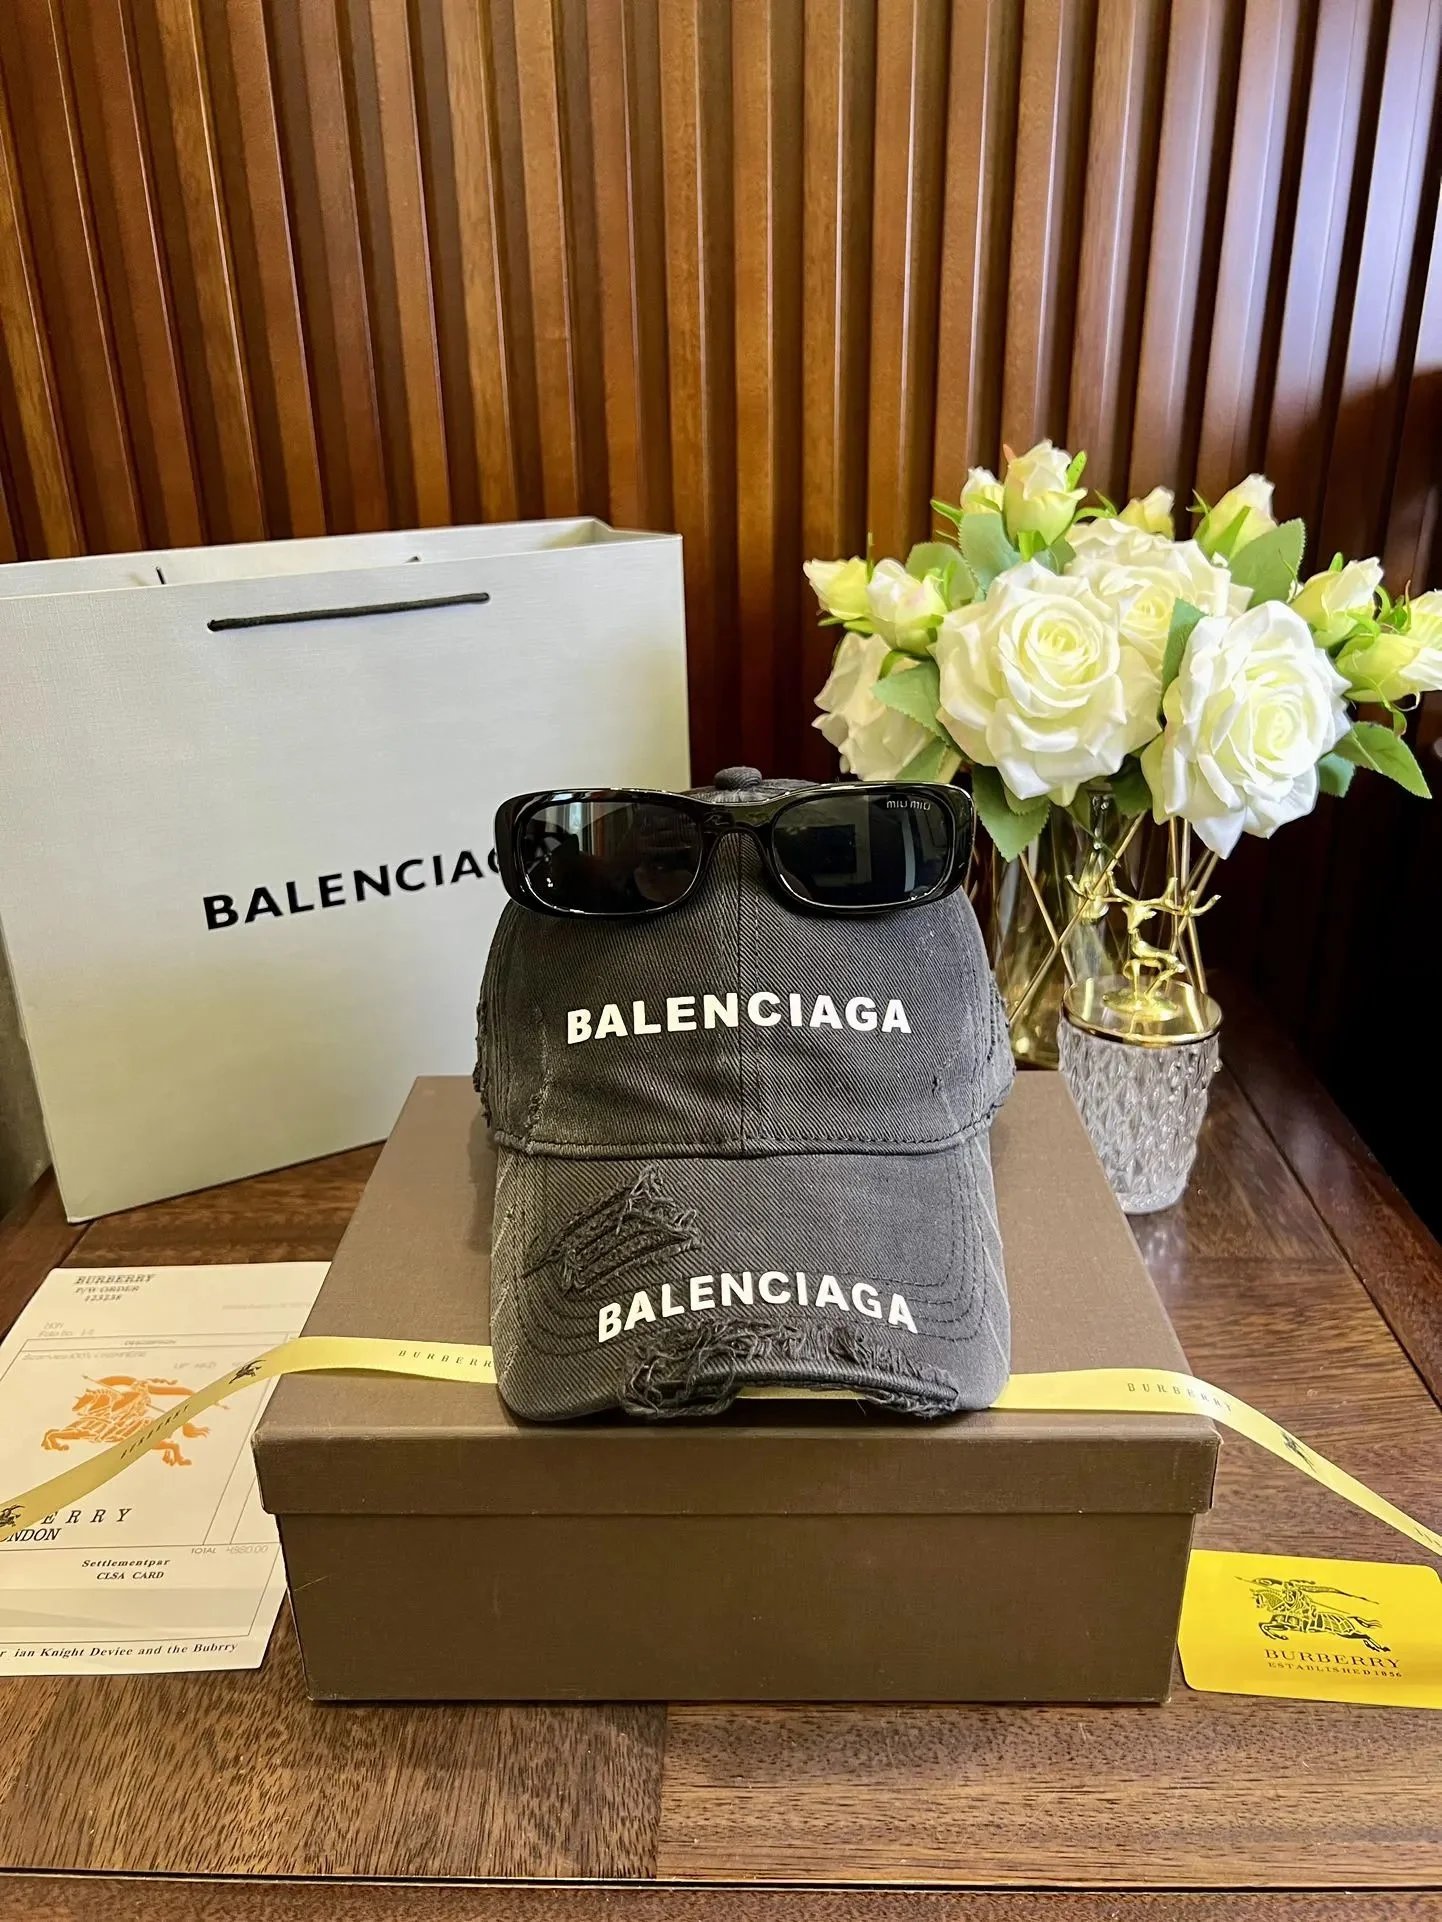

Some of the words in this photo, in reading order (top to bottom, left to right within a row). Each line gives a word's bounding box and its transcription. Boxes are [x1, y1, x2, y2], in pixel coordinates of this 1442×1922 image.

[203, 847, 500, 930] BALENCIA
[567, 991, 912, 1044] BALENCIAGA
[74, 1273, 155, 1285] BURBERRY
[598, 1270, 918, 1343] BALENCIAGA
[399, 1350, 493, 1368] BURBERR
[41, 1507, 132, 1525] ERRY
[1, 1527, 62, 1542] NDON
[191, 1546, 217, 1554] TOTAL
[132, 1571, 165, 1580] CARD
[40, 1647, 85, 1659] Knight
[138, 1645, 163, 1656] and
[167, 1644, 188, 1655] the
[1264, 1648, 1401, 1669] BURBERRY
